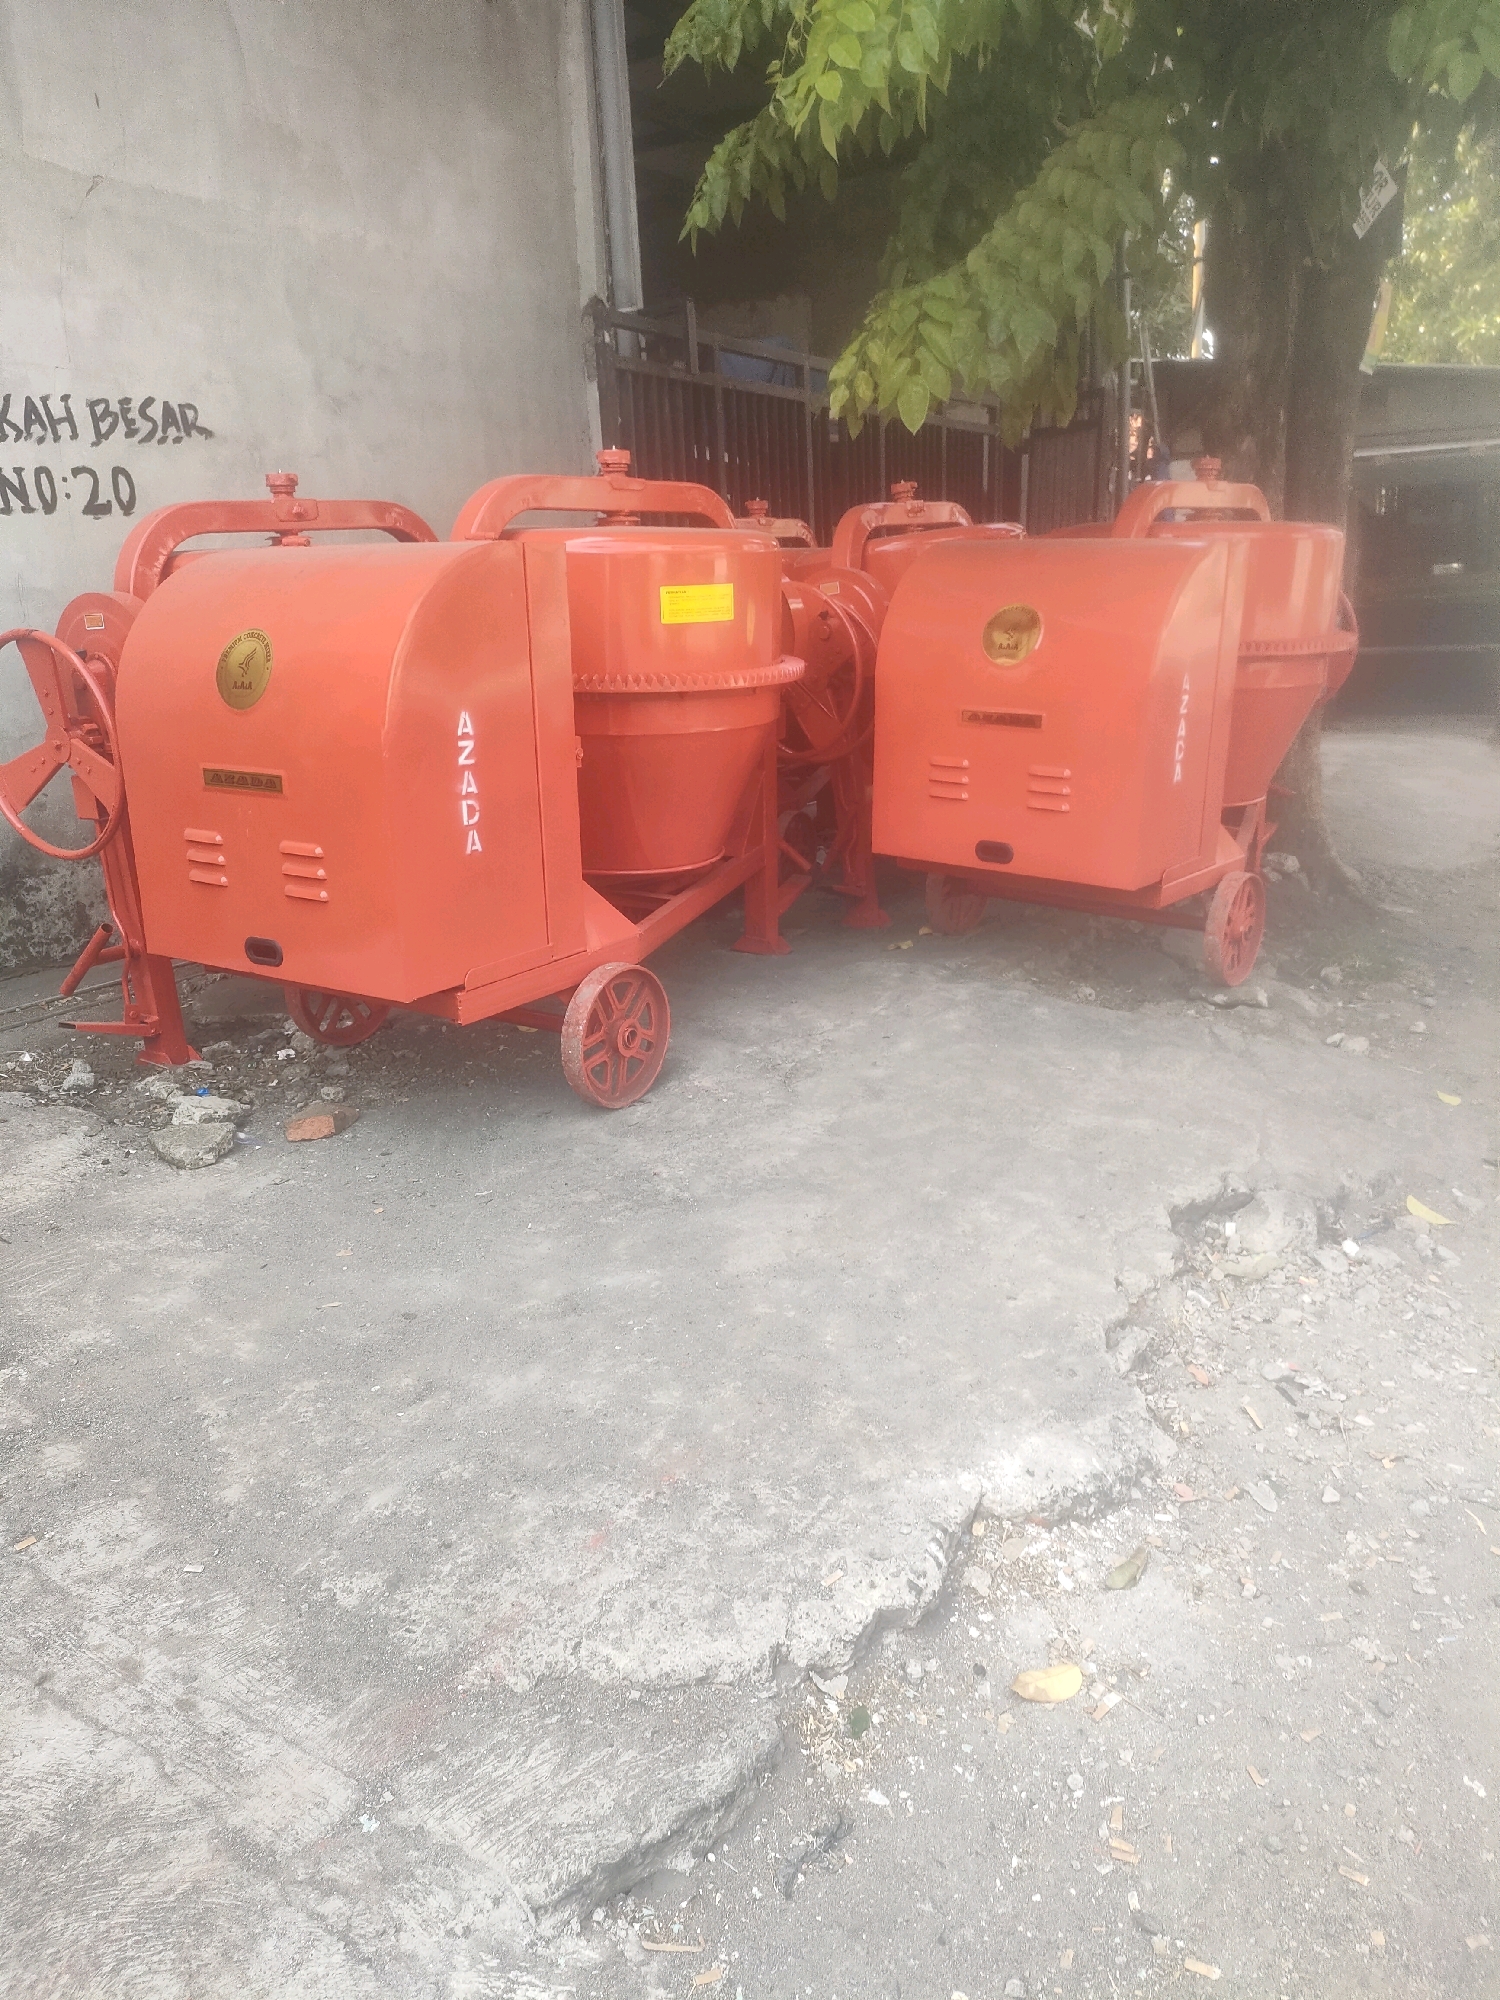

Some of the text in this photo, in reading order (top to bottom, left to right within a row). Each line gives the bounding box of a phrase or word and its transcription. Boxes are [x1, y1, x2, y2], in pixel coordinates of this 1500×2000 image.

[86, 396, 215, 447] BESAR
[1173, 672, 1190, 784] AZADA
[210, 772, 277, 789] AZADA
[457, 711, 483, 855] AZADA
